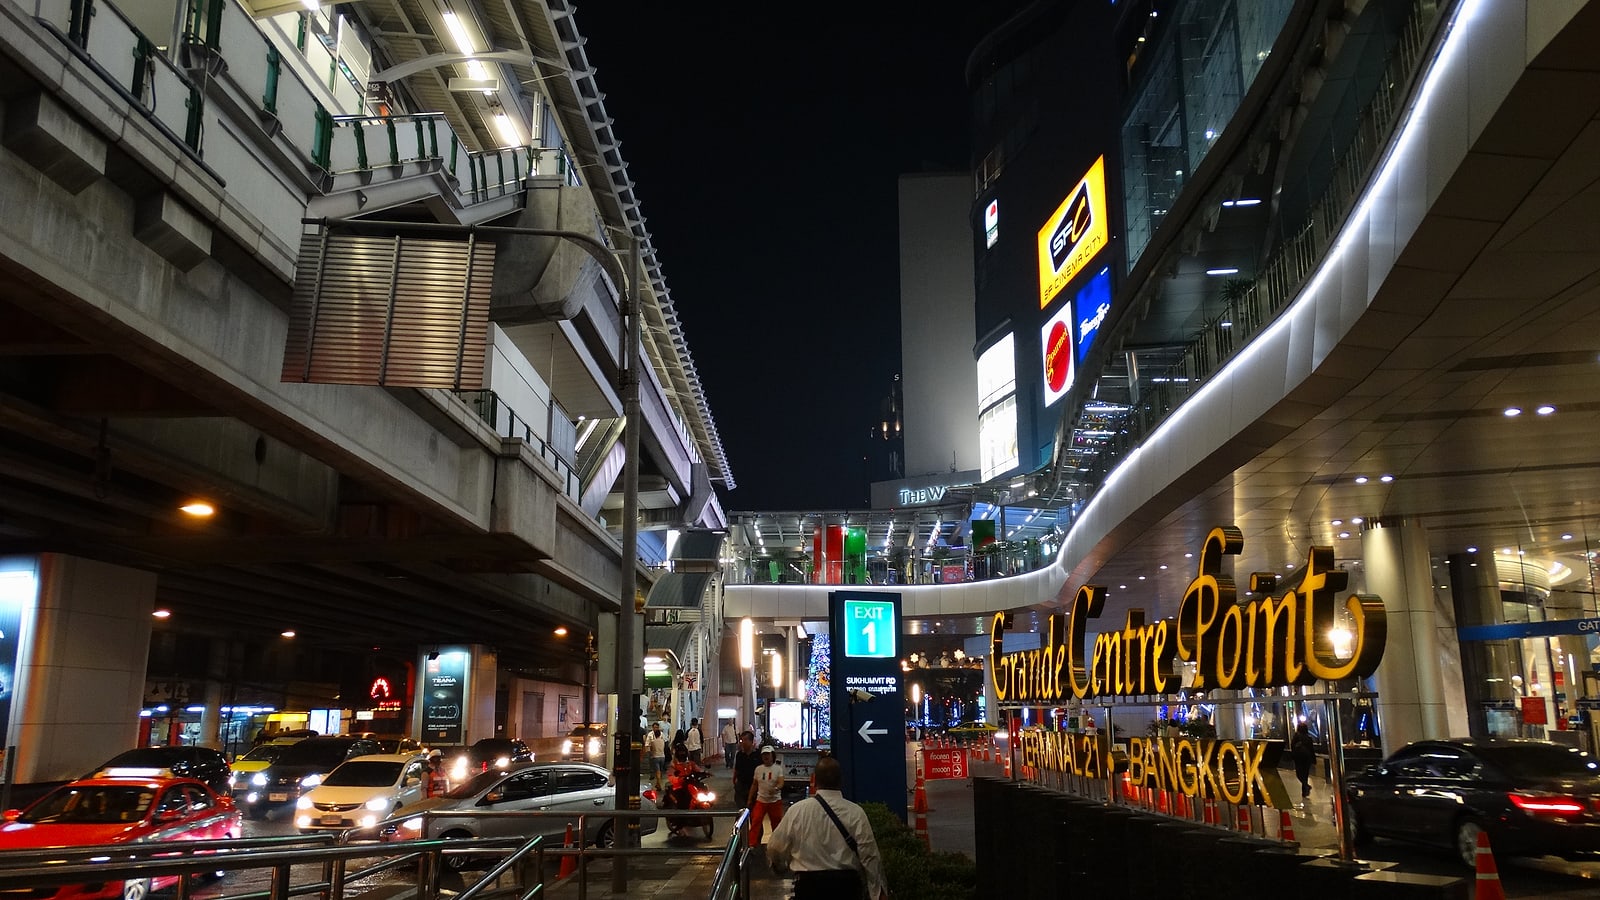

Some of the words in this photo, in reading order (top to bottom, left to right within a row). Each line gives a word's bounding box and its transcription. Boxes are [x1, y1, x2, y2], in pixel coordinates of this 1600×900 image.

[1054, 253, 1083, 289] CINEMA
[1084, 234, 1102, 258] CITY
[854, 606, 884, 619] EXIT
[990, 611, 1066, 700] Grande
[1069, 585, 1178, 699] Centre
[1178, 526, 1384, 690] Point
[862, 621, 876, 653] 1
[846, 676, 885, 685] SUKHUMVIT
[885, 676, 896, 685] RD
[1018, 732, 1082, 775] TERMINAL
[1083, 735, 1101, 779] 21
[1130, 737, 1274, 808] BANGKOK
